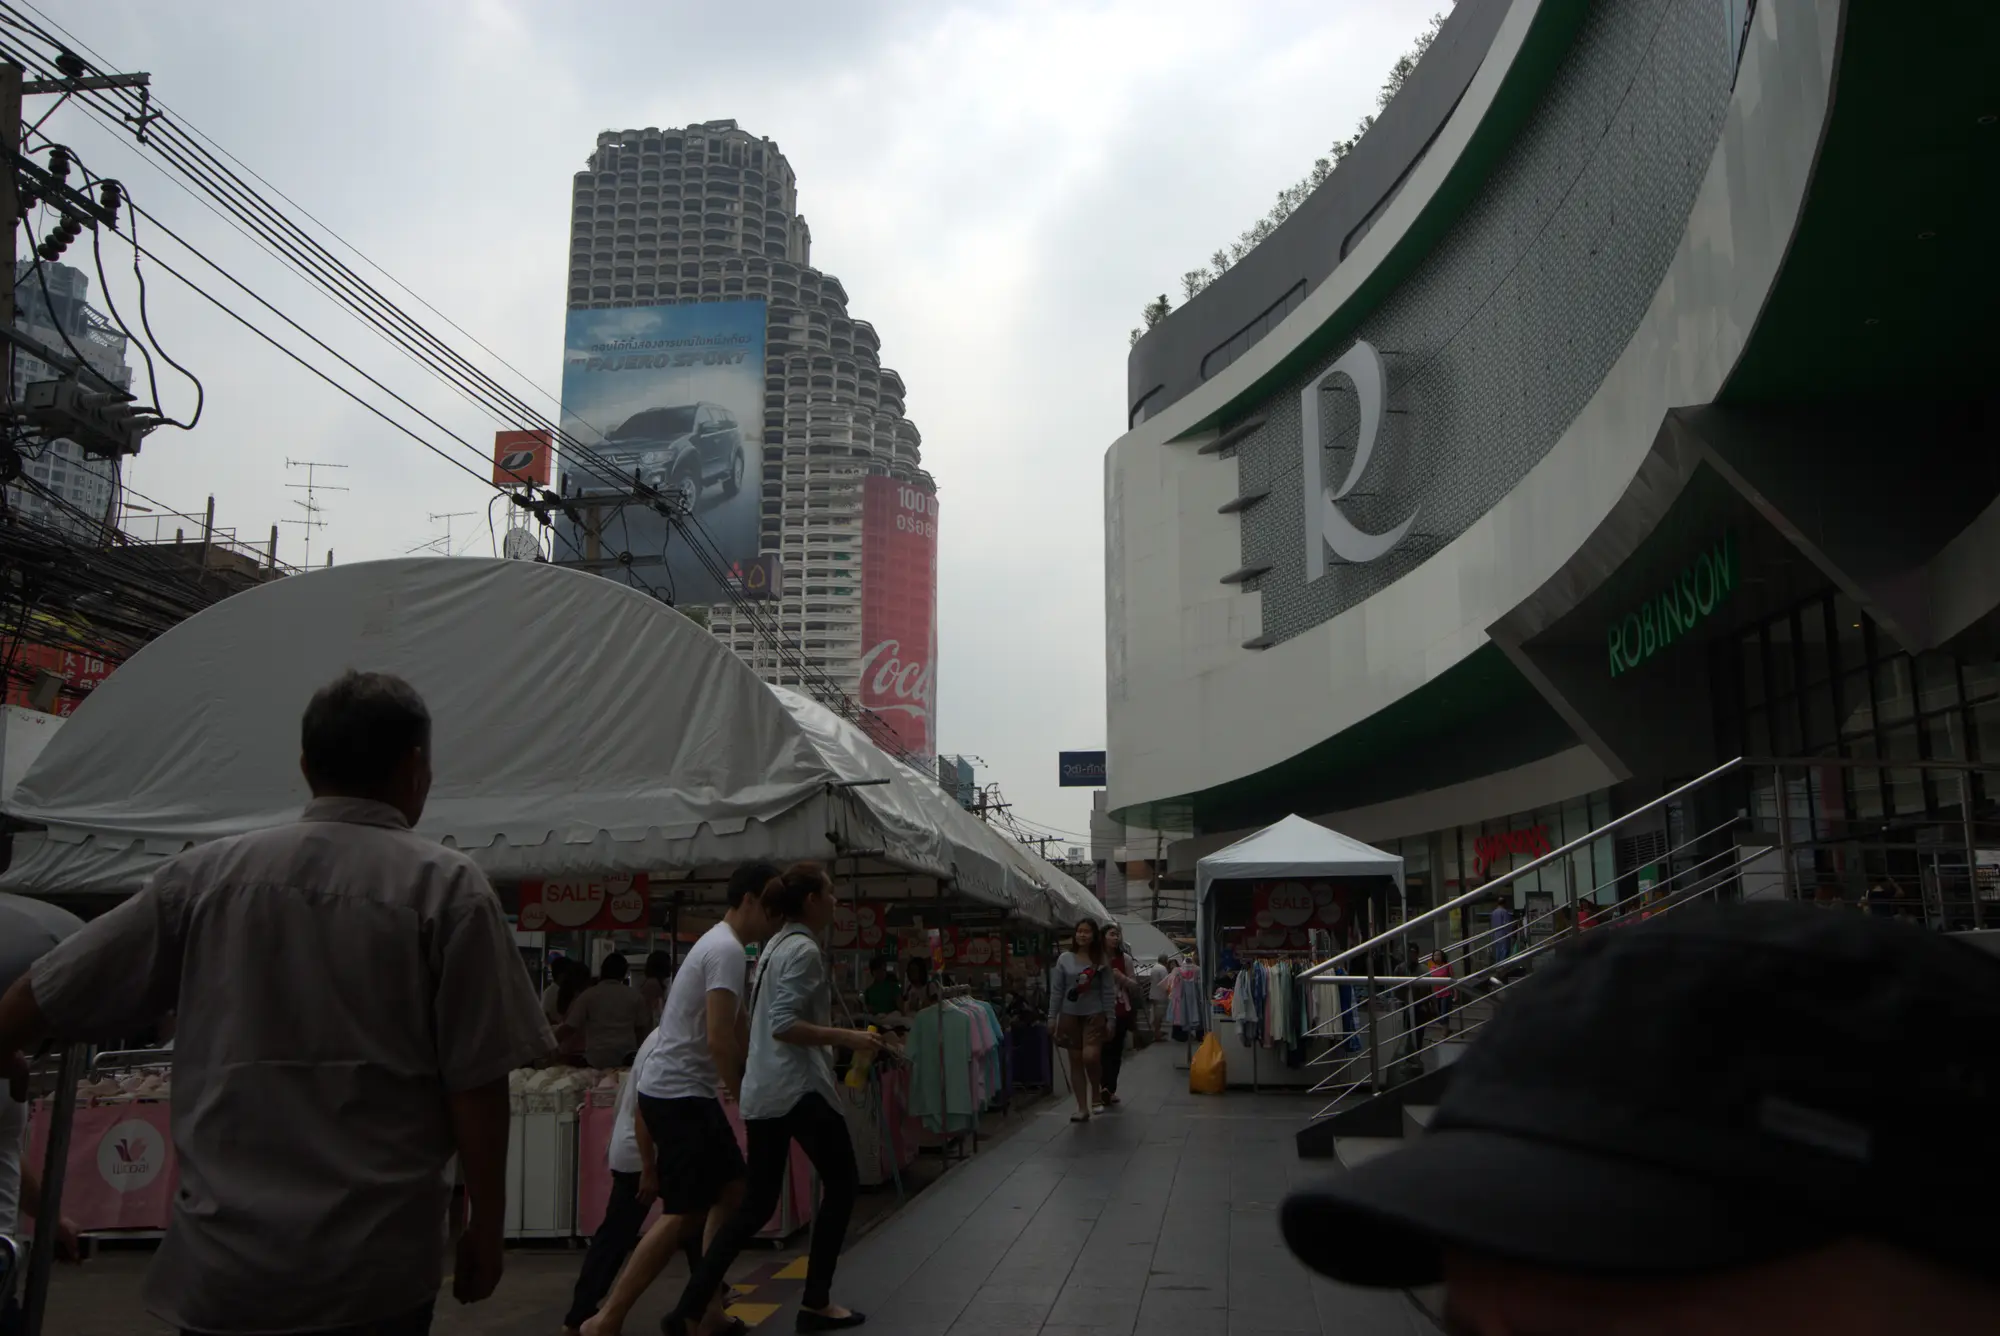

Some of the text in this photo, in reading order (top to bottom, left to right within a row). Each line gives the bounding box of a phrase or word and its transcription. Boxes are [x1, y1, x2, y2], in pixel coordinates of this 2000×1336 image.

[585, 350, 750, 373] PAJERO SPORT
[897, 486, 925, 513] 100
[1608, 524, 1731, 679] ROBINSON
[546, 884, 601, 902] SALE
[1271, 896, 1311, 909] SALE
[612, 900, 641, 910] SALE
